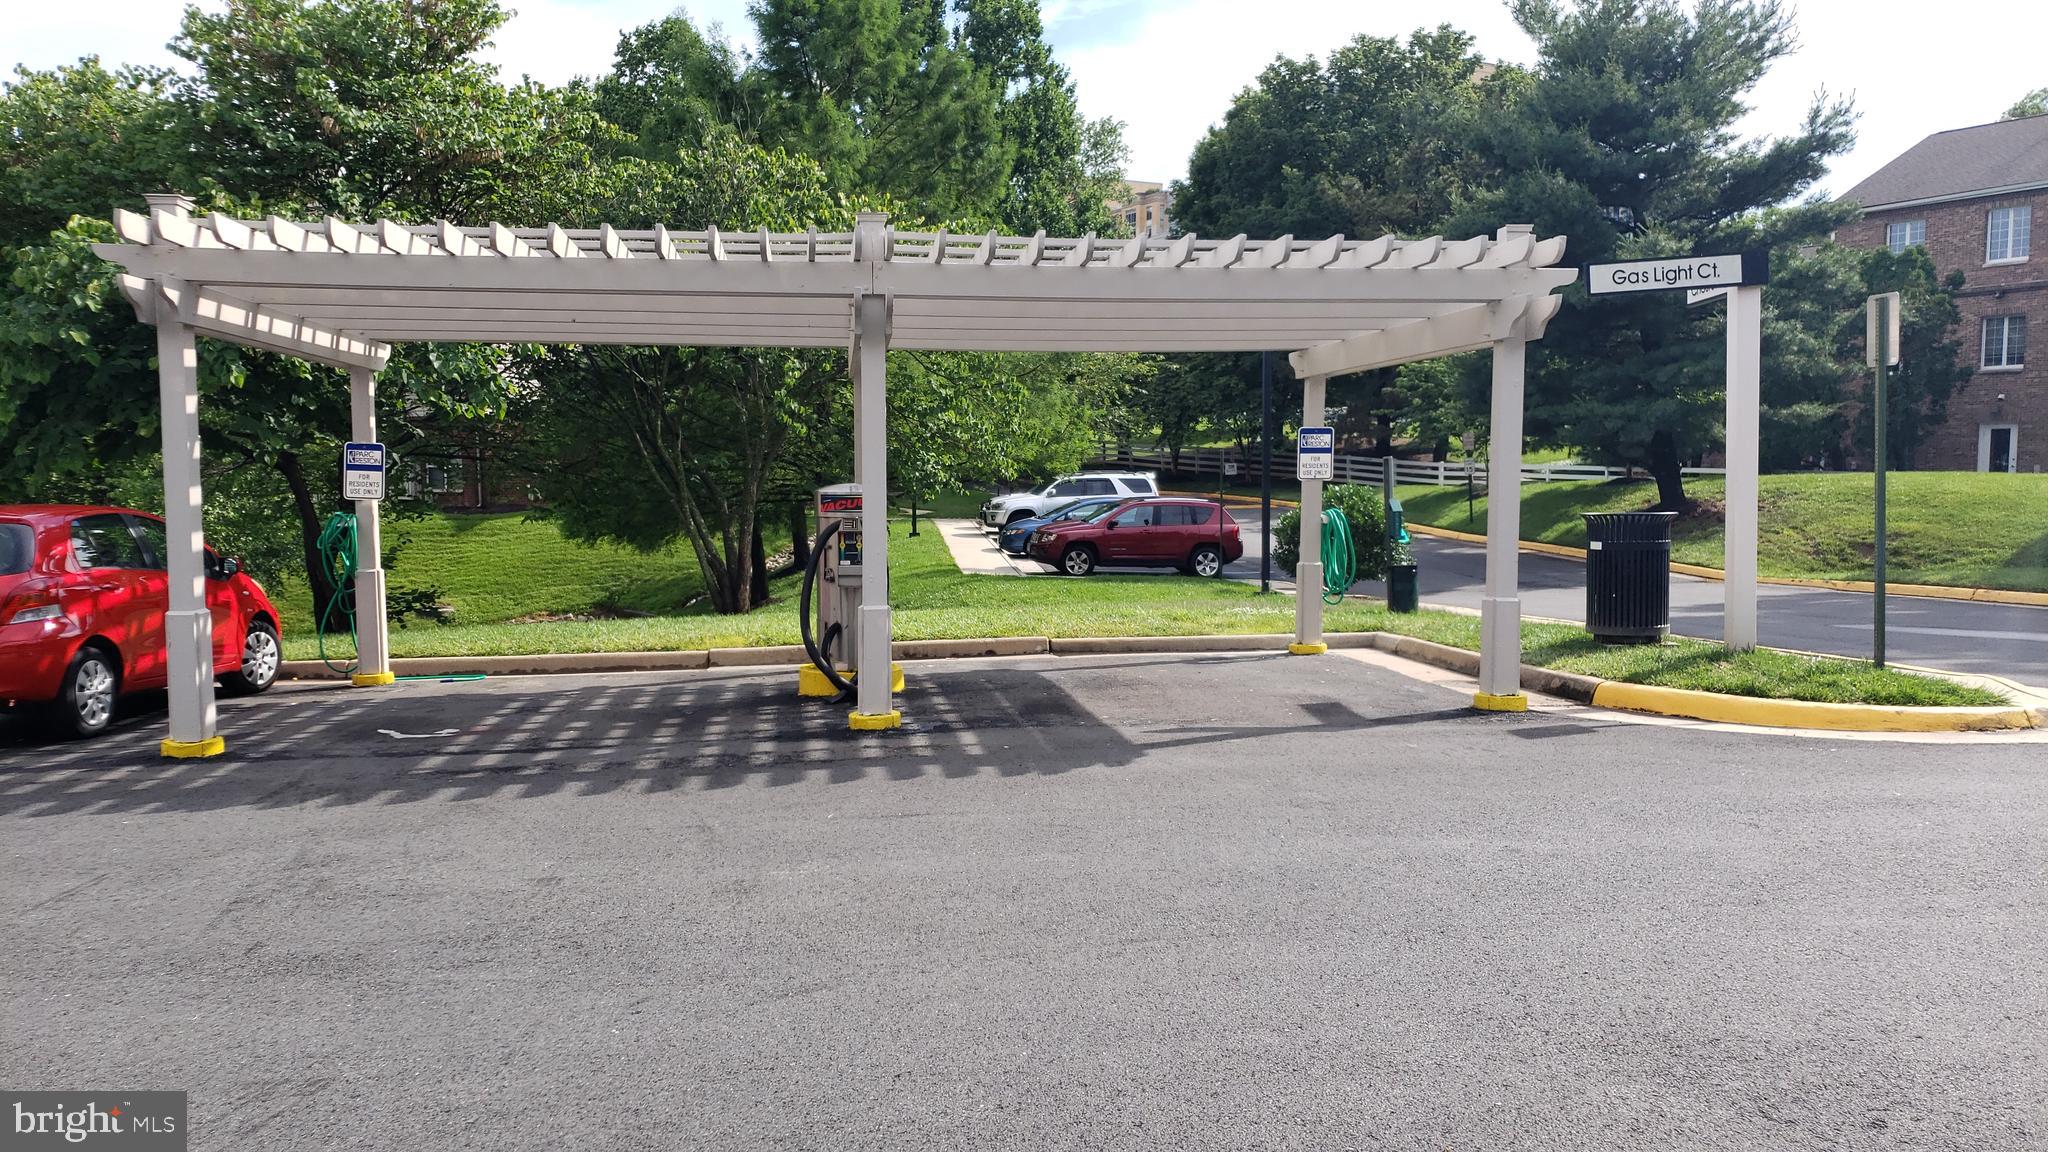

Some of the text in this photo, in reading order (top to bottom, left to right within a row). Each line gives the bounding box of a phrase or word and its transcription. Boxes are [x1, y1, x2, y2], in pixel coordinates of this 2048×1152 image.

[1612, 263, 1720, 286] Gas Light Ct.
[821, 497, 862, 512] VACU
